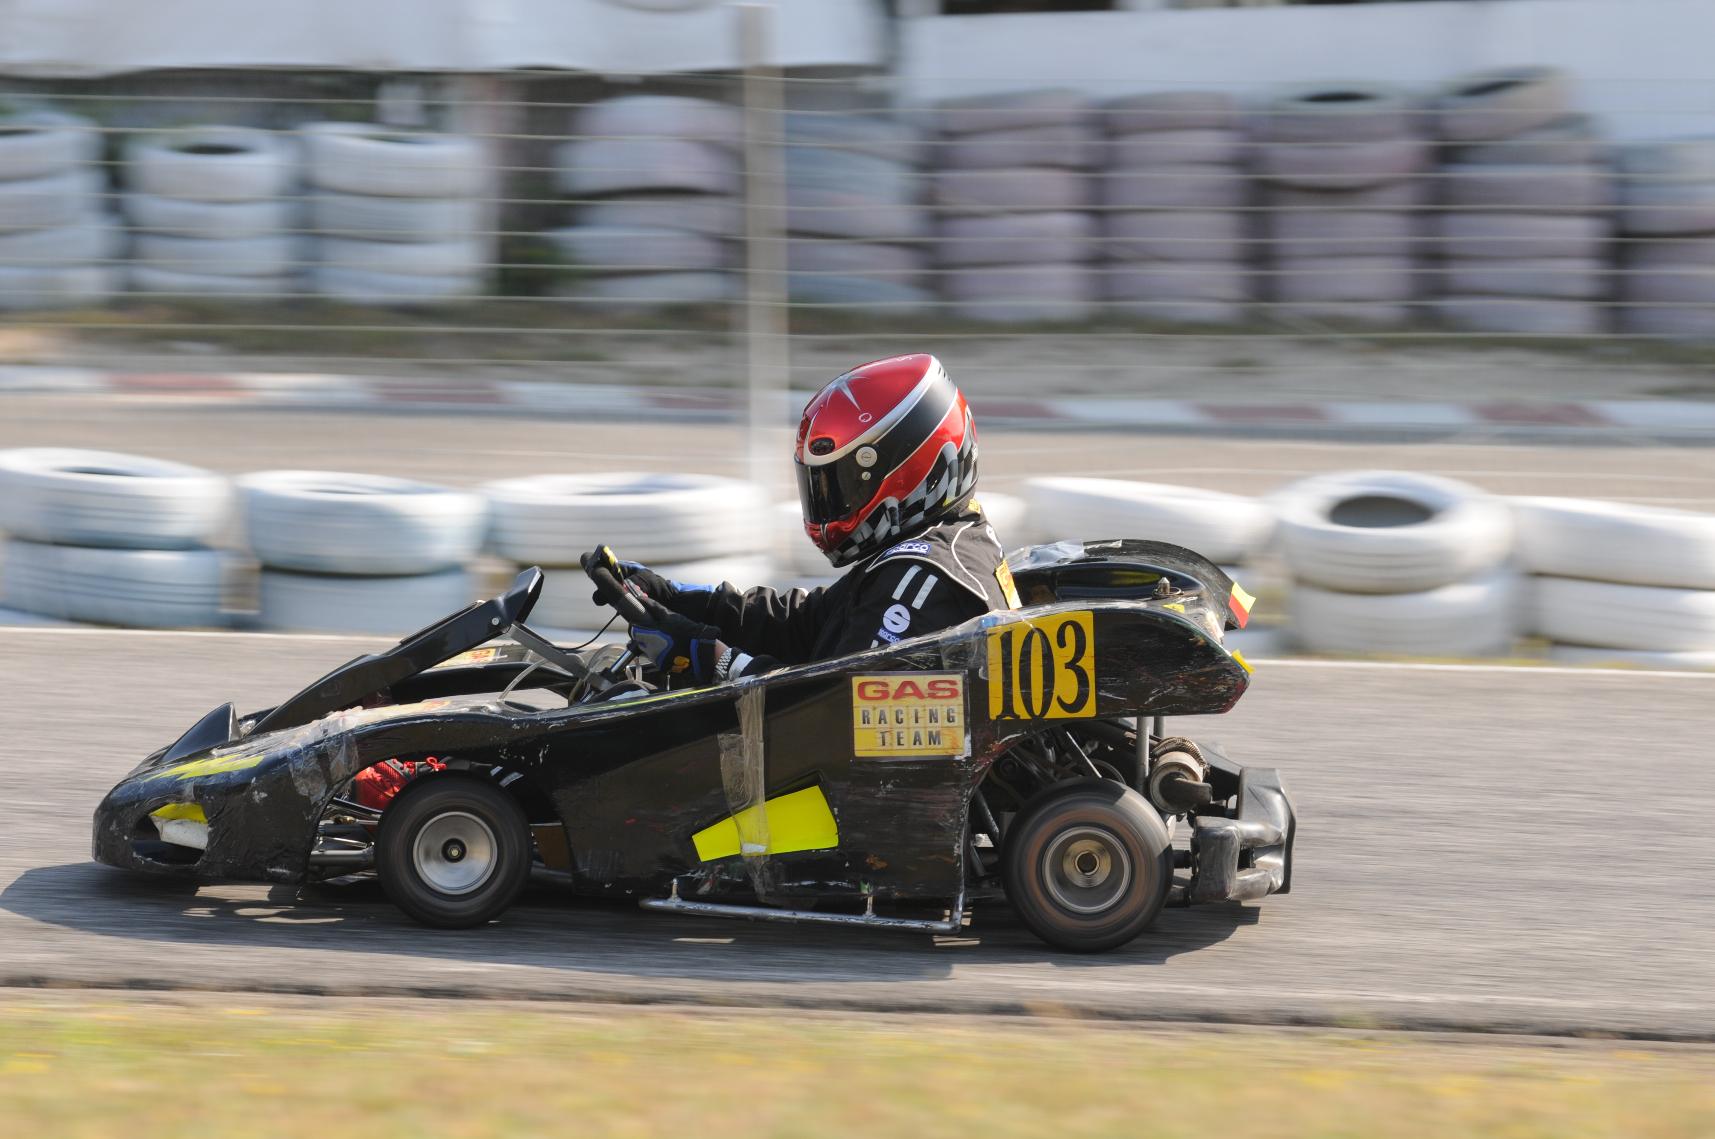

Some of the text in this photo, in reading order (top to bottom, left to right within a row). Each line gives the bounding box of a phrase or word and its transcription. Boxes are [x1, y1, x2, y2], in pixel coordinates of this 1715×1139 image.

[996, 620, 1090, 719] 103
[857, 680, 960, 701] GAS
[862, 708, 956, 725] RACING
[879, 731, 941, 747] TEAM
